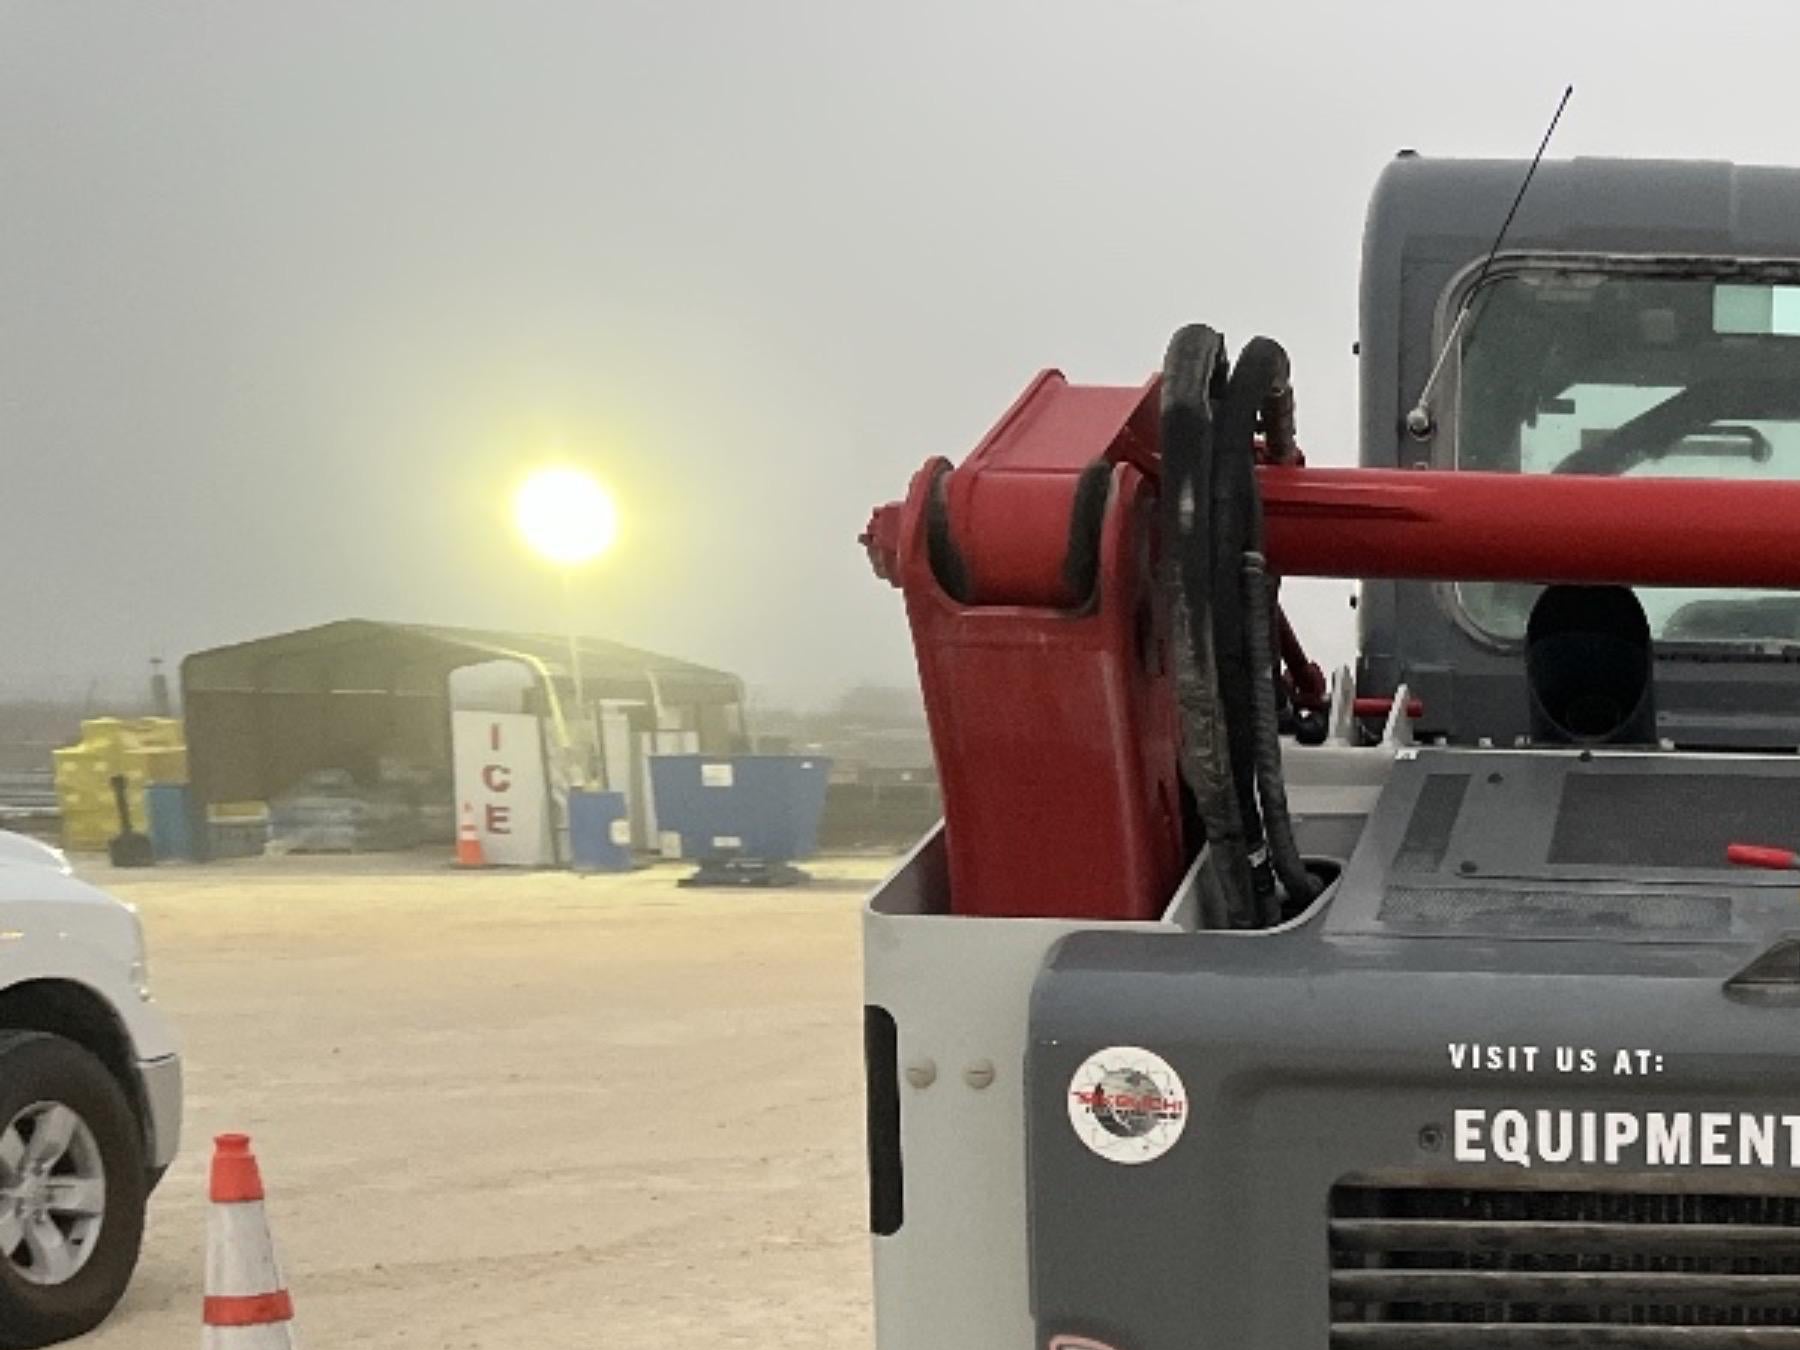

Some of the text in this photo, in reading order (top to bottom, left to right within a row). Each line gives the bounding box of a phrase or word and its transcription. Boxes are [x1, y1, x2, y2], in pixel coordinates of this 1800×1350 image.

[480, 722, 512, 835] ICE
[1448, 1043, 1664, 1075] VISIT US AT:
